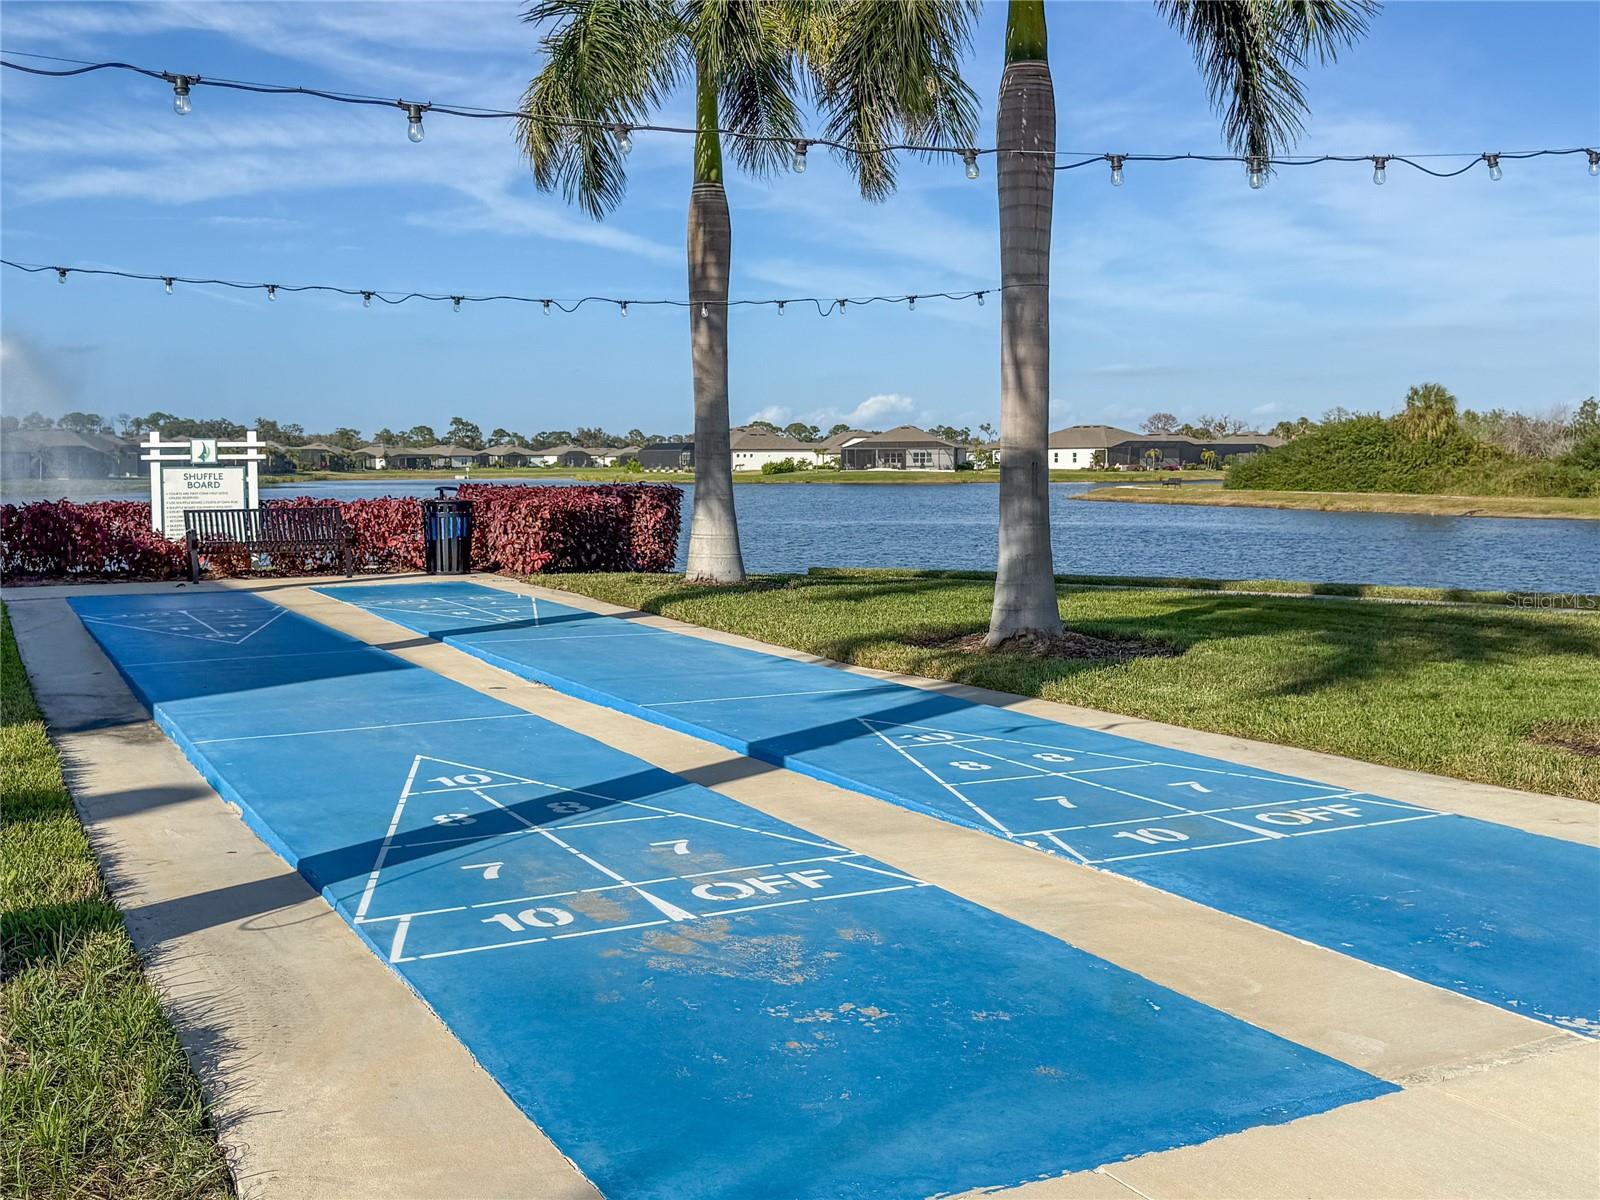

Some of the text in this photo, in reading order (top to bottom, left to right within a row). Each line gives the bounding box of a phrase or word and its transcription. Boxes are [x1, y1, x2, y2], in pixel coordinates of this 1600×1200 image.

[183, 472, 223, 481] SHUFFLE
[188, 481, 220, 489] BOARD
[1031, 752, 1074, 762] 8
[948, 760, 992, 771] 8
[428, 773, 492, 786] 10
[1167, 781, 1212, 794] 7
[546, 801, 591, 814] 8
[1033, 795, 1079, 809] 7
[432, 813, 476, 826] 8
[1254, 803, 1362, 827] OFF
[1112, 827, 1190, 845] 10
[649, 838, 691, 855] 7
[460, 862, 505, 880] 7
[691, 869, 835, 901] OFF
[481, 907, 574, 932] 10
